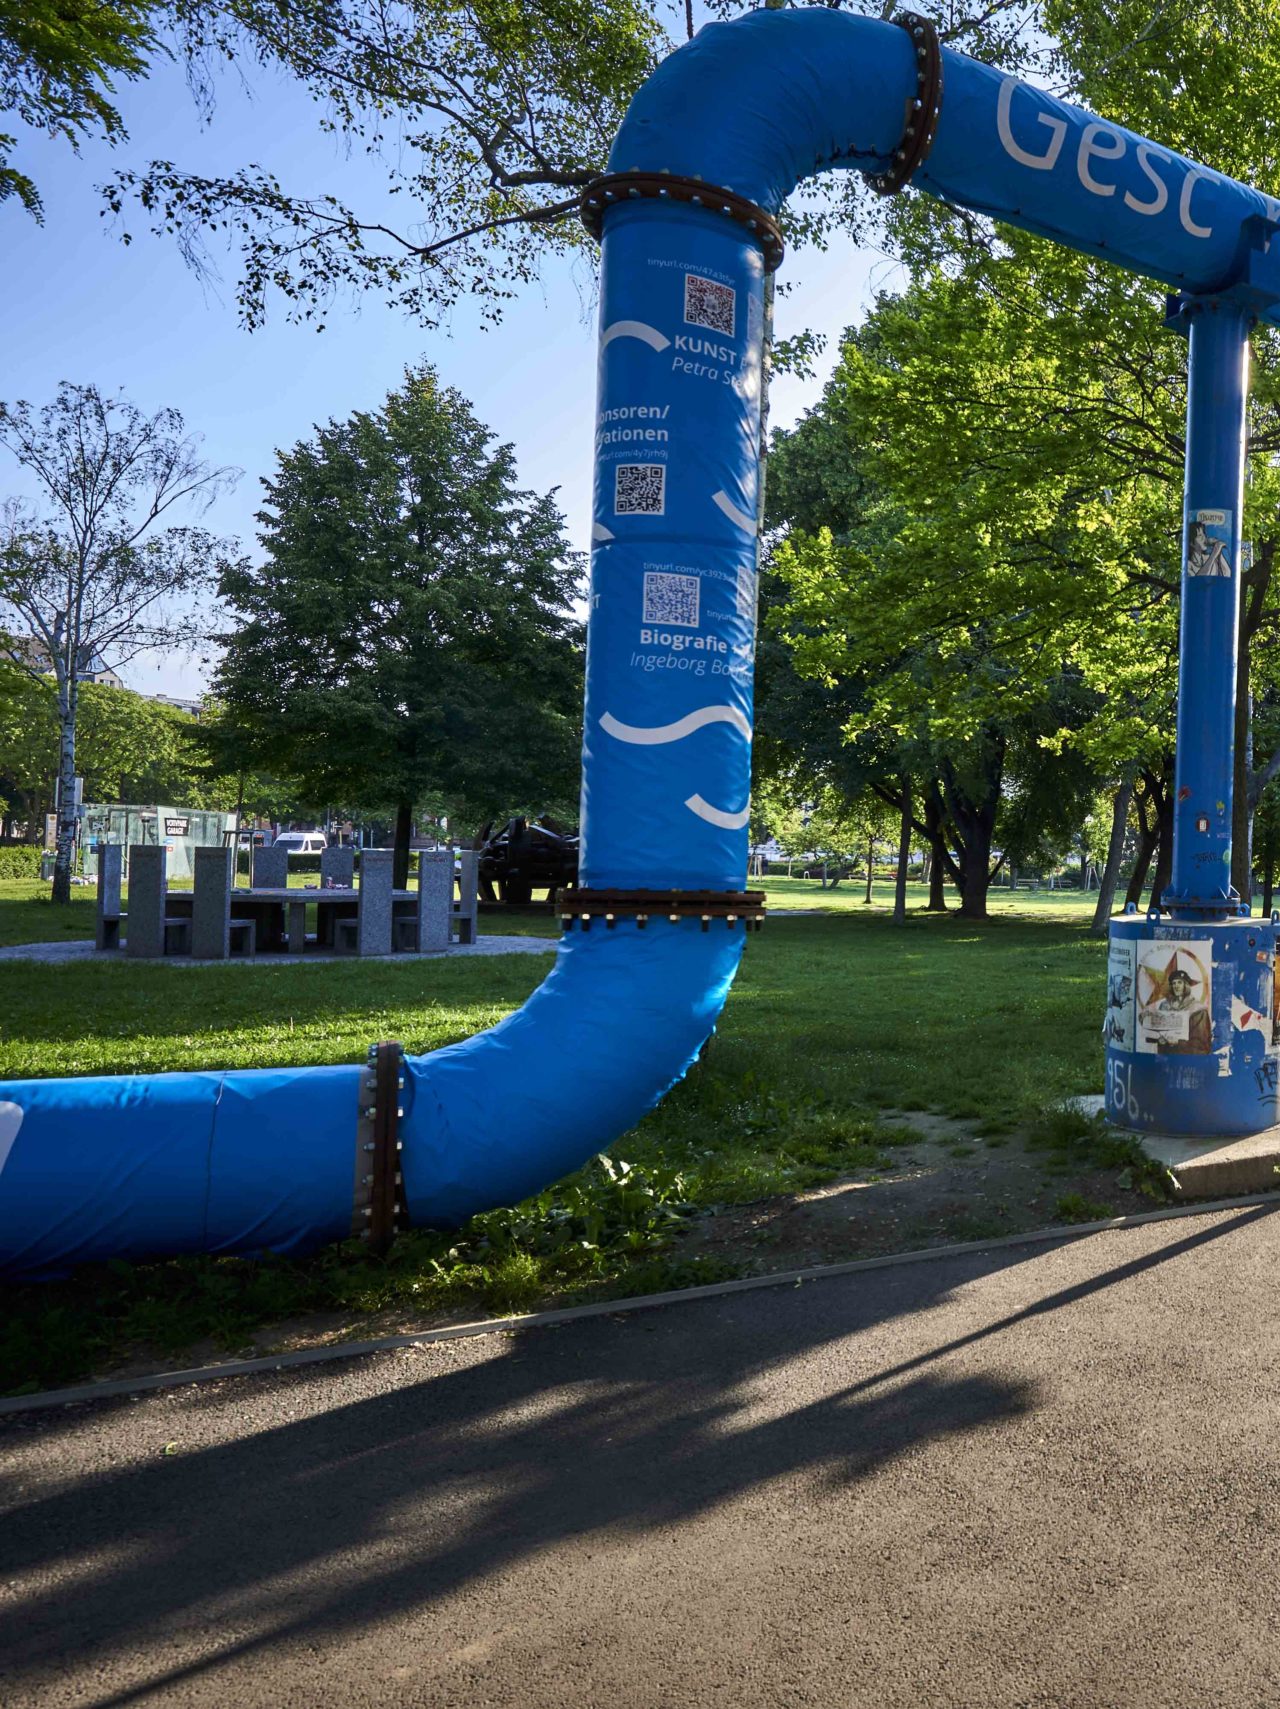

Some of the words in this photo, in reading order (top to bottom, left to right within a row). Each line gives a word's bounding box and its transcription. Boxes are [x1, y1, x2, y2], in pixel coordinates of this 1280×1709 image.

[674, 334, 737, 366] KUNST
[671, 356, 719, 380] Petra
[640, 629, 728, 654] Biografie
[629, 651, 706, 676] Ingeborg
